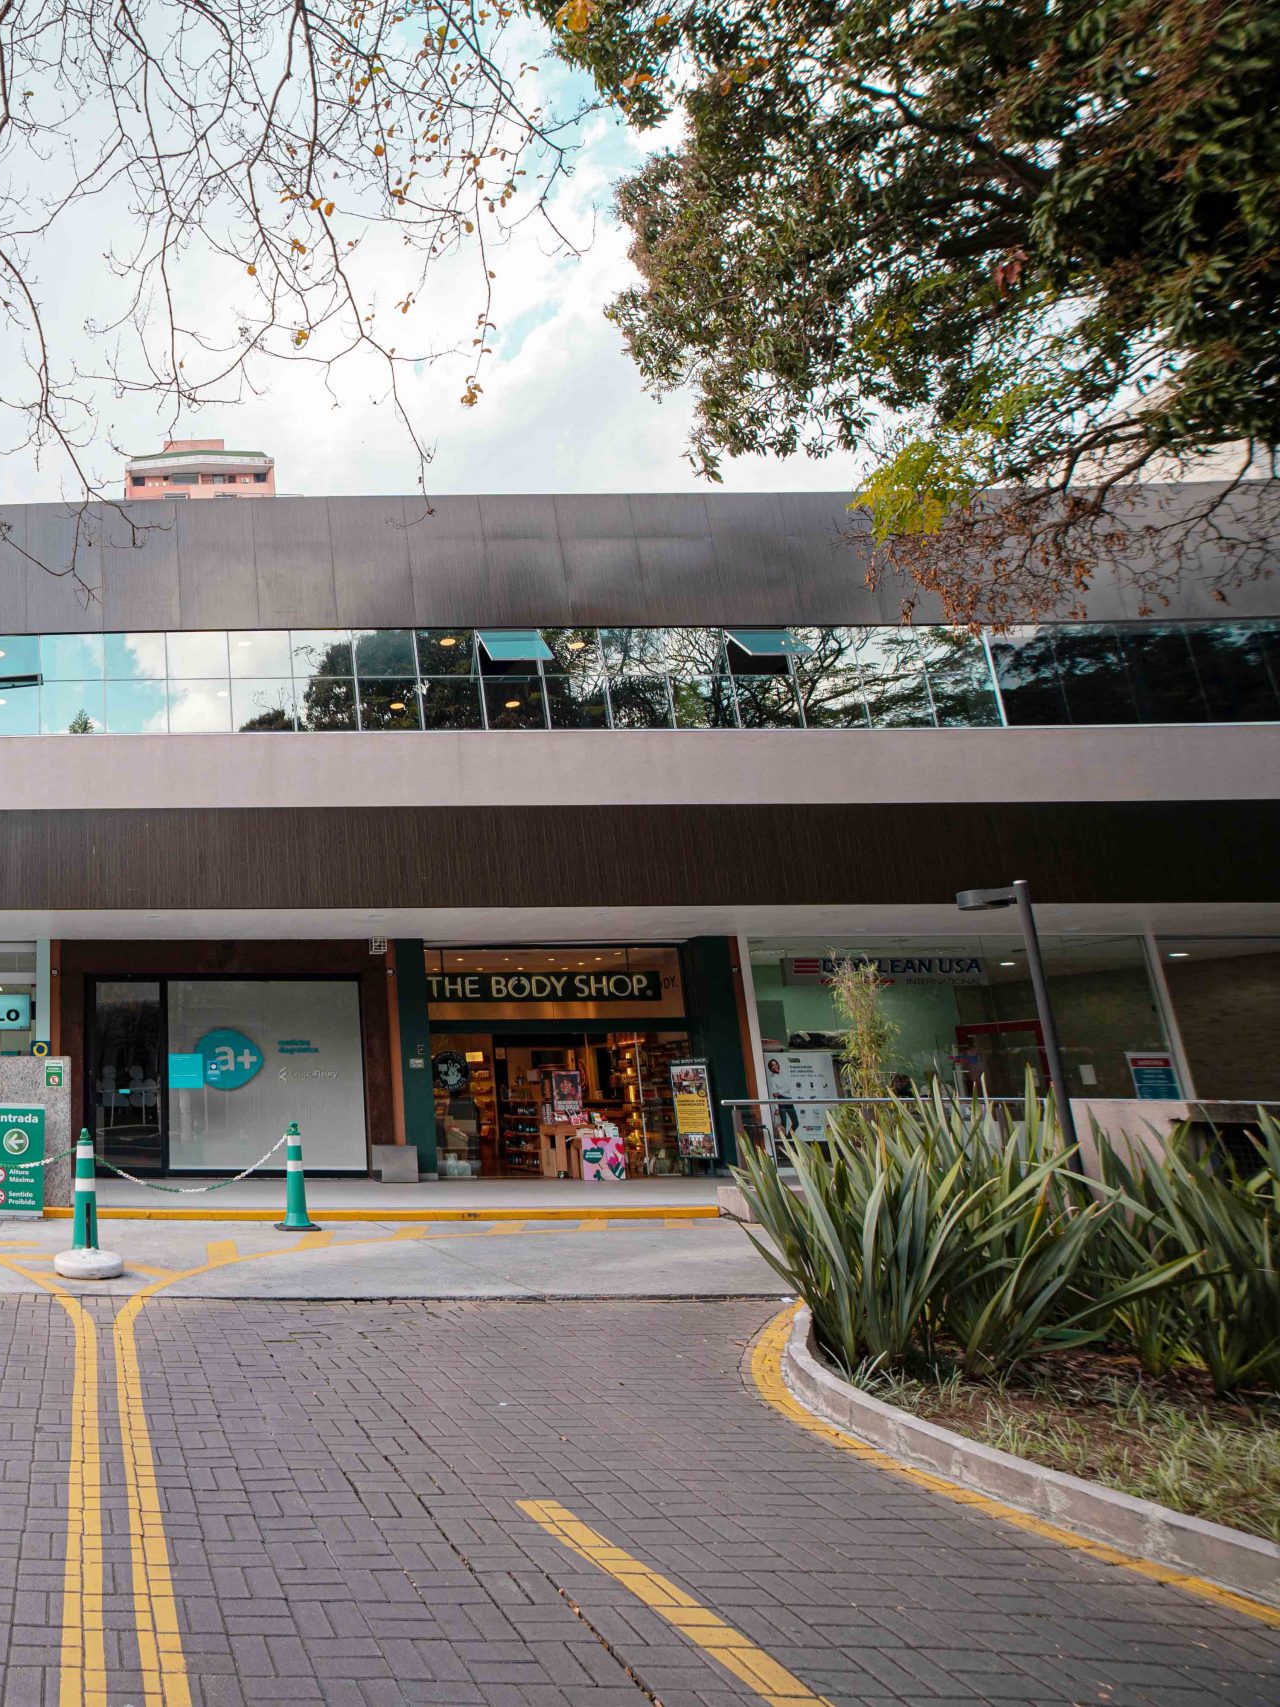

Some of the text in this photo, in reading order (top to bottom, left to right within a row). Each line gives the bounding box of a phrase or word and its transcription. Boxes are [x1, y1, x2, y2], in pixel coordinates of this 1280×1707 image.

[938, 959, 982, 974] USA
[427, 975, 648, 998] THE BODY SHOP
[906, 977, 982, 986] INTERNATIONAL
[214, 1046, 258, 1072] a+
